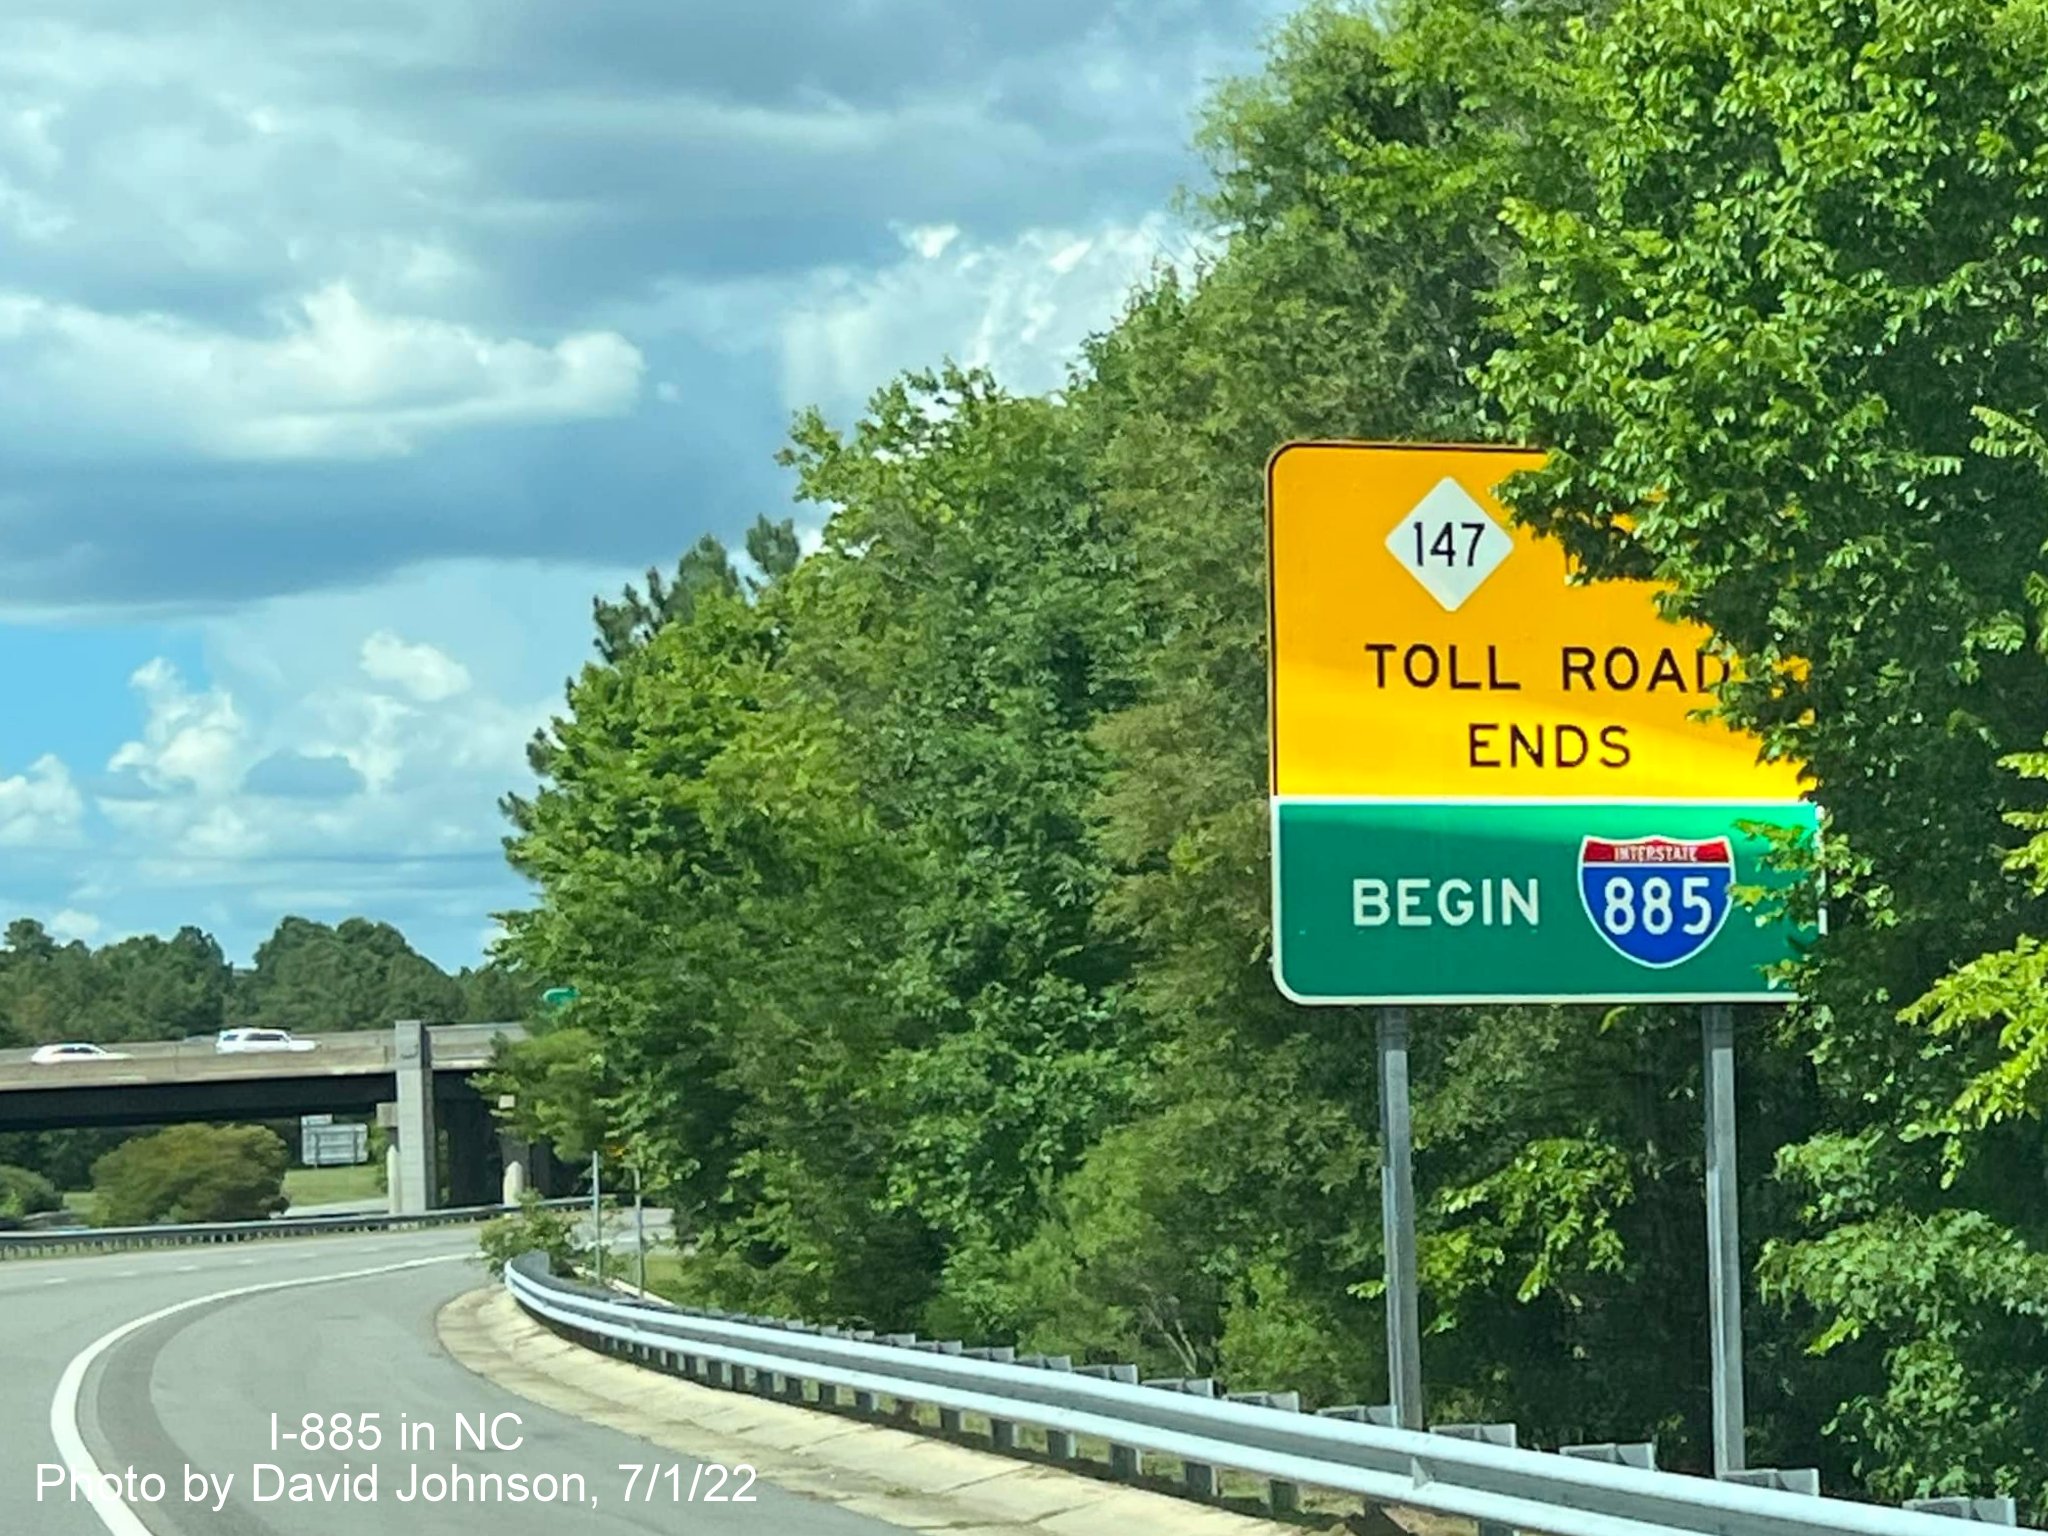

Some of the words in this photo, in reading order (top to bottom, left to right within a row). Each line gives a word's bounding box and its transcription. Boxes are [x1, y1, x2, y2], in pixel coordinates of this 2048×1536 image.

[1413, 522, 1486, 567] 147
[1365, 643, 1521, 691] TOLL
[1562, 646, 1730, 693] ROAD
[1468, 723, 1631, 768] ENDS
[1613, 845, 1698, 863] INTERSTATE
[1352, 878, 1539, 927] BEGIN
[1604, 876, 1712, 935] 885
